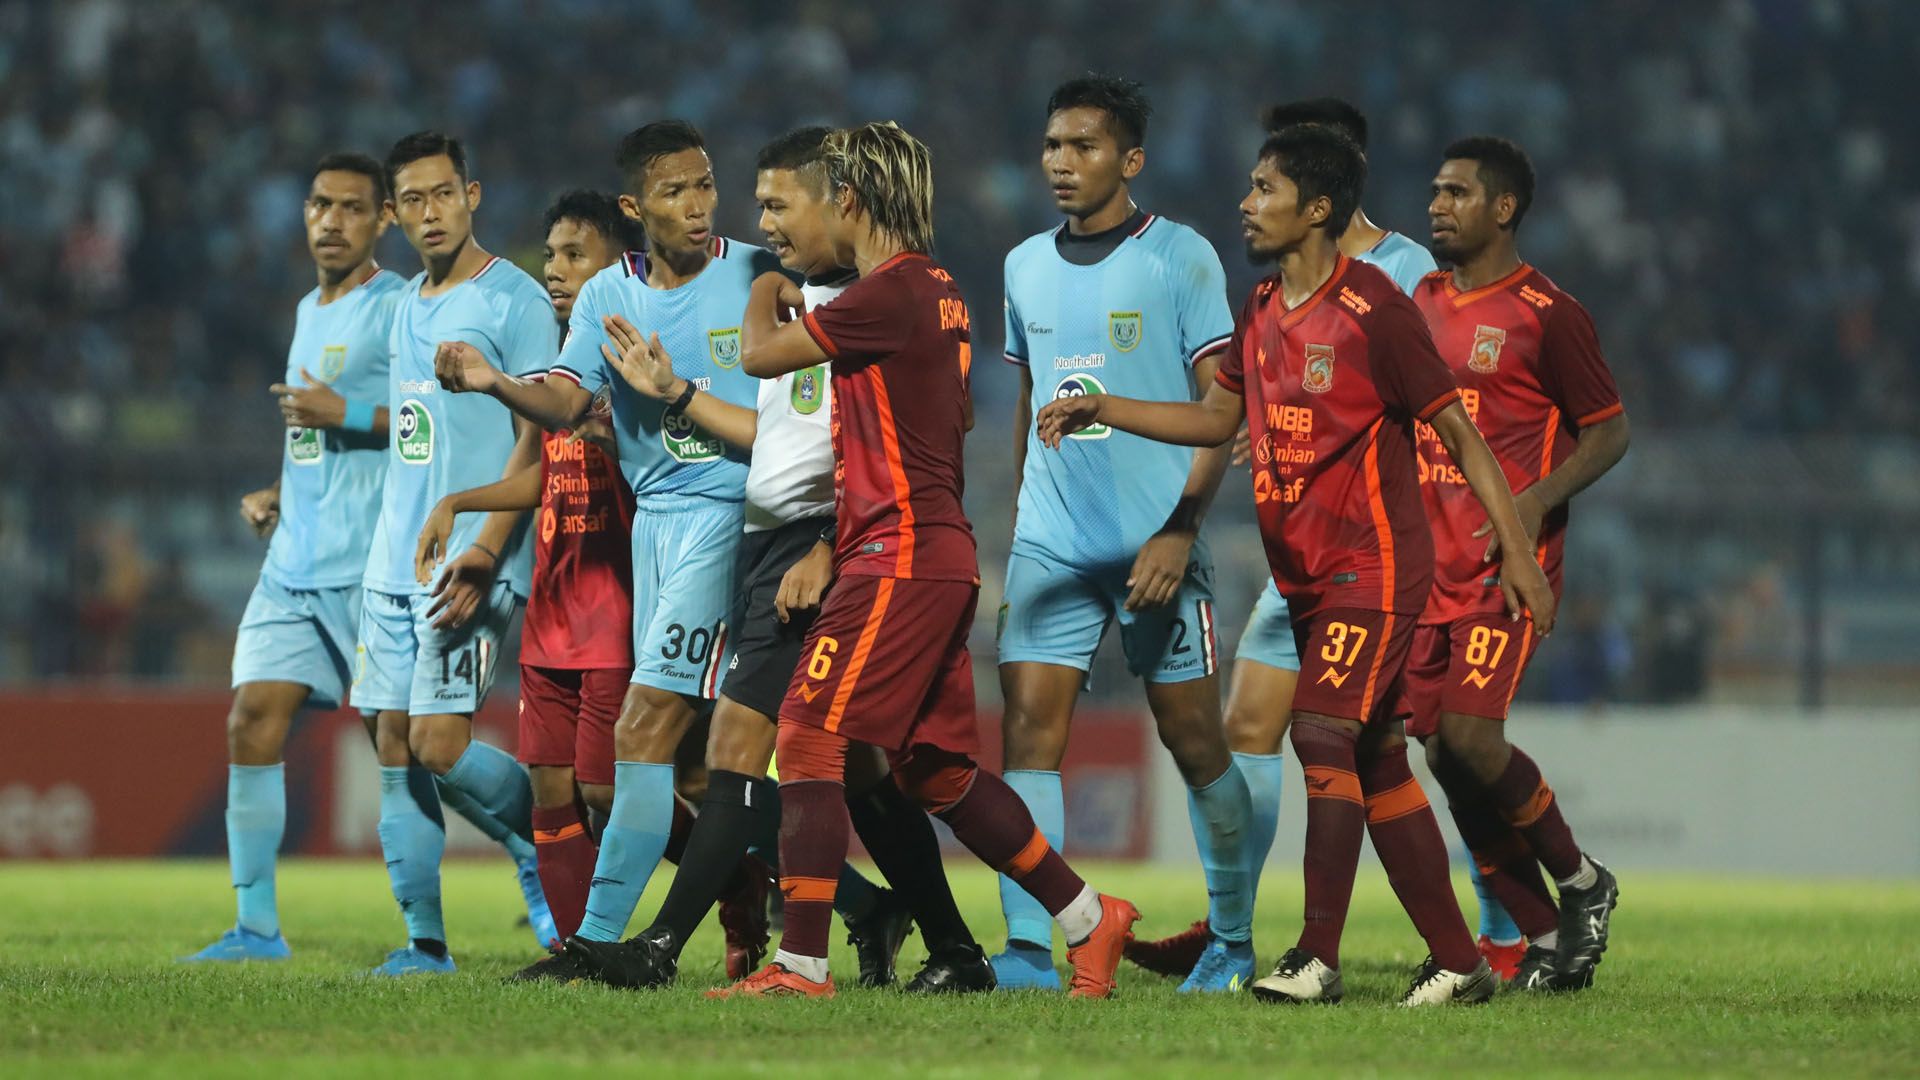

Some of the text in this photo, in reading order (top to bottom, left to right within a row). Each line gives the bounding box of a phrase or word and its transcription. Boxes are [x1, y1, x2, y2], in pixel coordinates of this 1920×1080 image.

[1054, 353, 1106, 370] Northcliff
[399, 413, 415, 431] SO
[1290, 430, 1313, 443] BOLA
[402, 442, 430, 456] NICE
[677, 439, 720, 458] NICE
[661, 623, 710, 665] 30
[1169, 617, 1191, 656] 2
[1321, 621, 1368, 668] 37
[1465, 625, 1510, 670] 87
[440, 648, 473, 685] 14
[807, 636, 839, 680] 6
